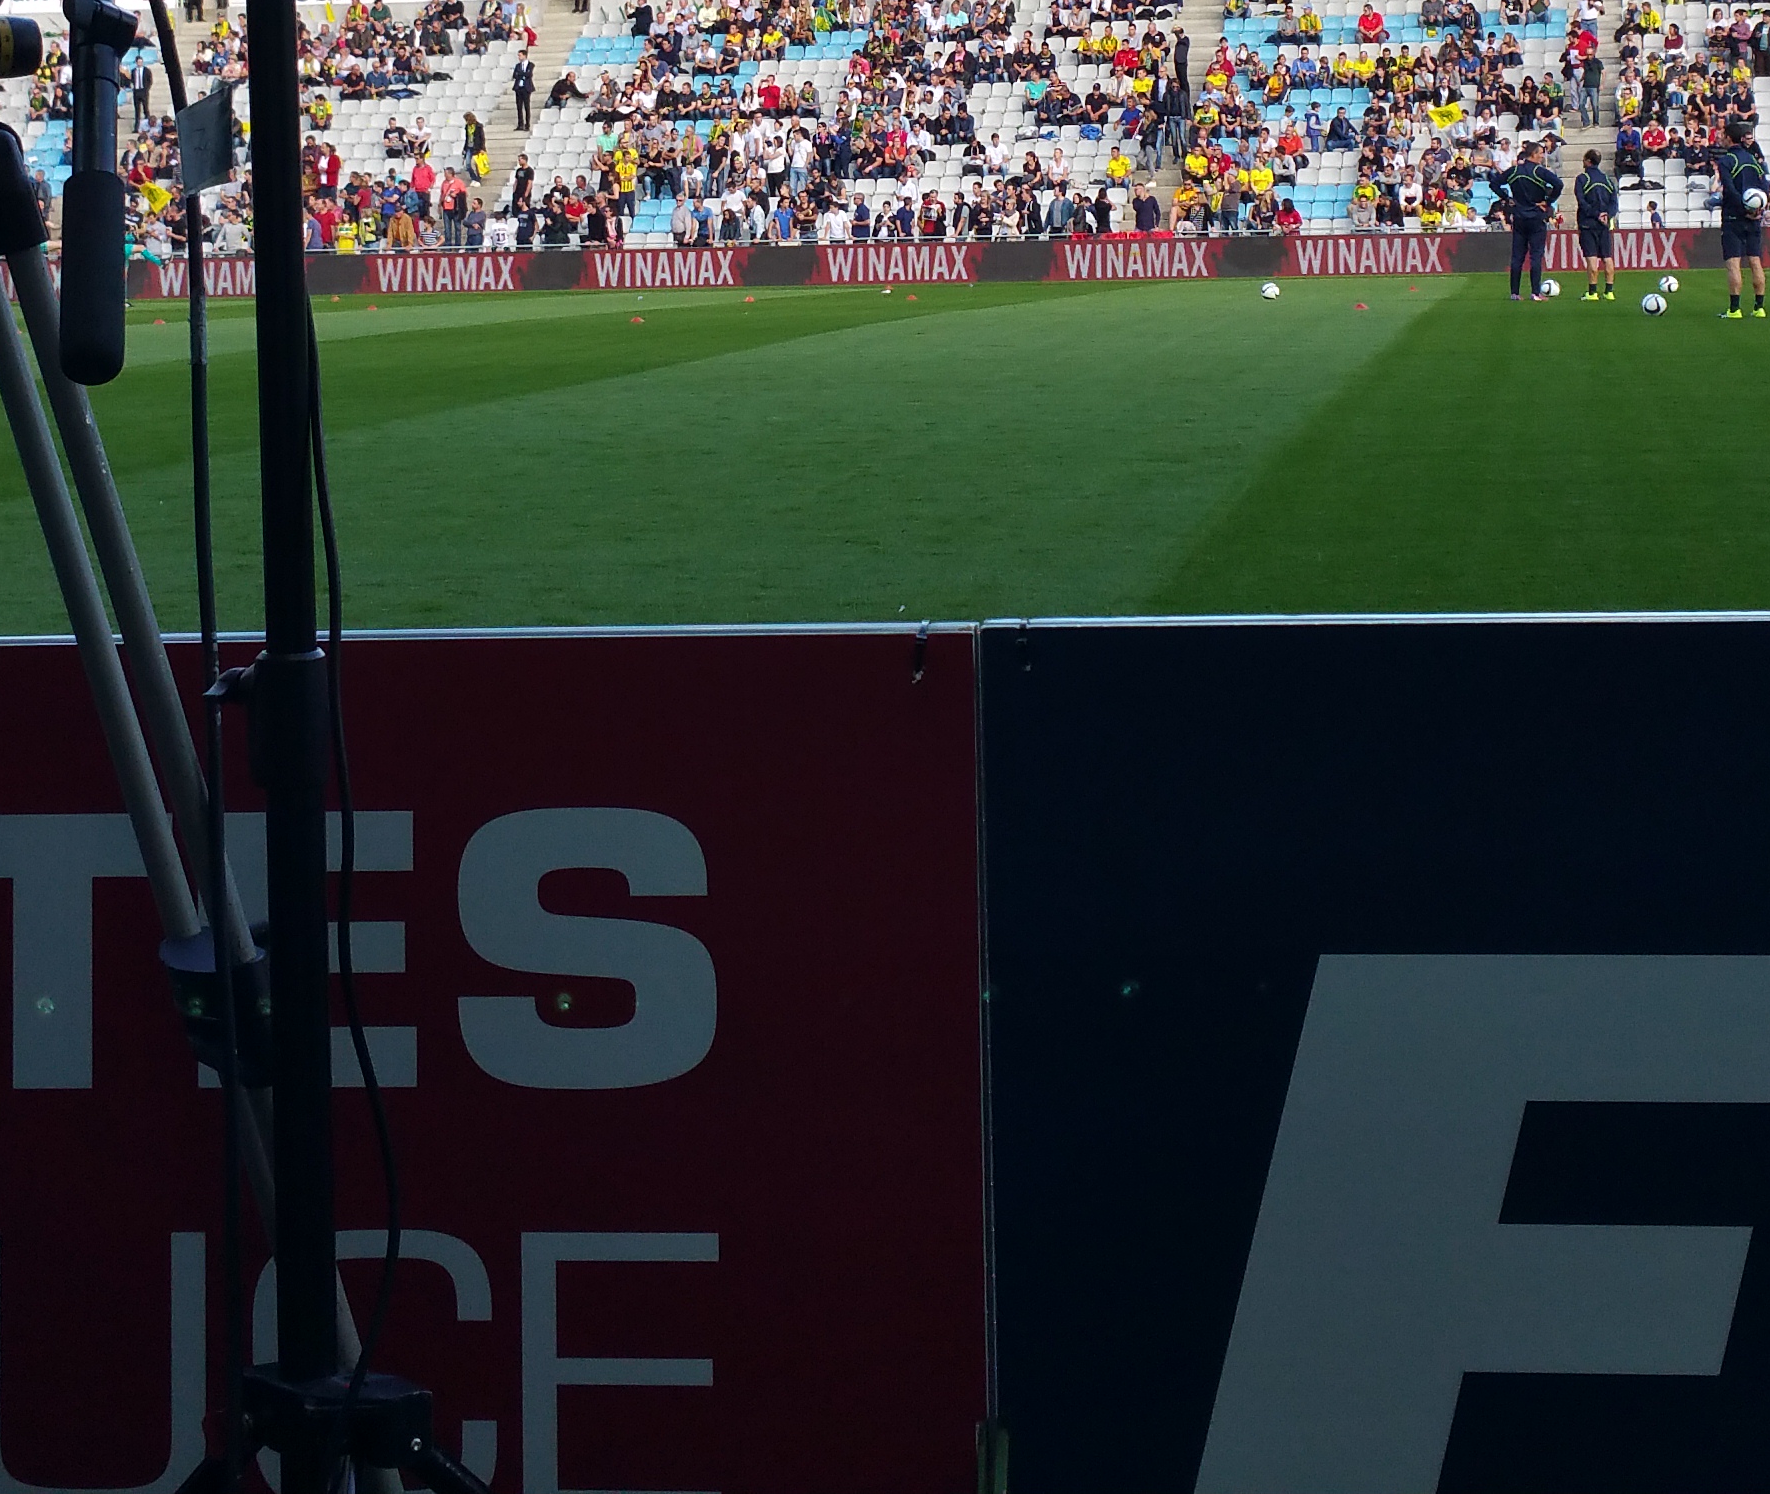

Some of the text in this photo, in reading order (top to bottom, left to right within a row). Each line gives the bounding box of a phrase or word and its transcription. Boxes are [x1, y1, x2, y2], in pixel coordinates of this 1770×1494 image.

[594, 250, 735, 288] WINAMAX
[827, 245, 968, 283] WINAMAX
[1064, 241, 1209, 279] WINAMAX
[1295, 237, 1442, 275] WINAMAX
[1544, 231, 1679, 270] WINMAX
[159, 258, 255, 297] WNAM
[377, 256, 515, 292] WINAMAX
